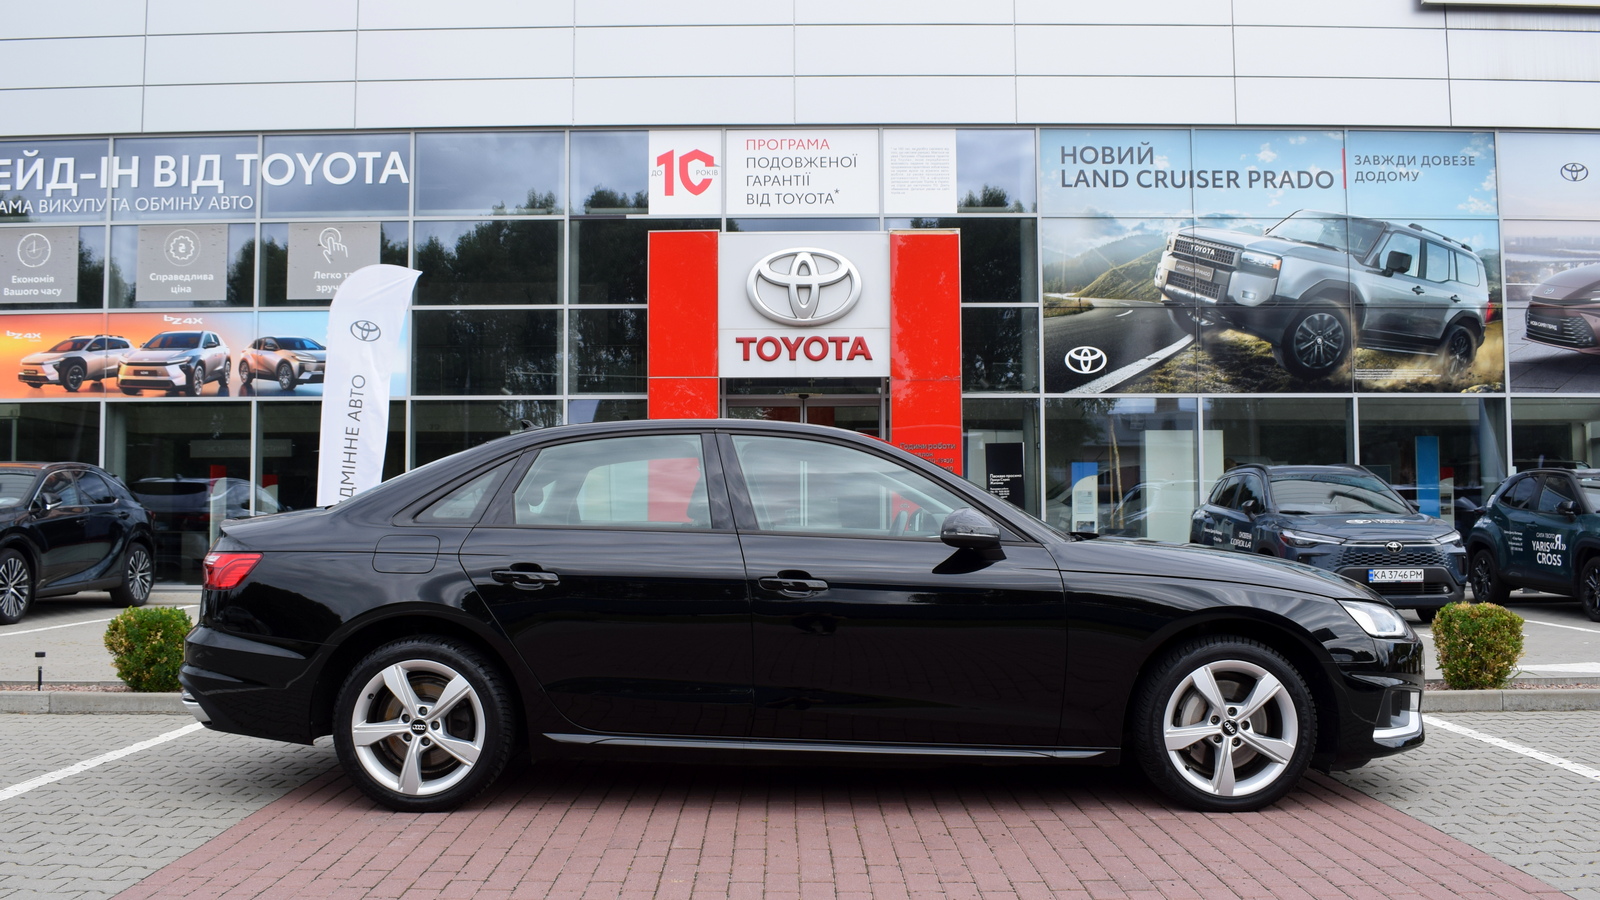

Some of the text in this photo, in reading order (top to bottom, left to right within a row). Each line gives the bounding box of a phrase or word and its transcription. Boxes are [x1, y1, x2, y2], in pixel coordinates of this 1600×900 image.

[746, 138, 830, 151] ПРОГРАМА
[1060, 141, 1154, 165] НОВИЙ
[746, 153, 858, 171] ПОДОВЖЕНОЇ
[1354, 155, 1476, 168] ЗАВЖДИ ДОВЕЗЕ
[154, 155, 224, 194] ВІД
[235, 151, 410, 186] TOYOTA
[651, 169, 663, 177] ДО
[746, 171, 812, 187] ГАРАНТІЇ
[1354, 171, 1420, 183] ДОДОМУ
[1060, 169, 1335, 190] LAND CRUISER PRADO
[38, 198, 107, 213] ВИКУПУ
[111, 197, 131, 212] ТА
[135, 196, 204, 212] ОБМІНУ
[208, 195, 254, 210] АВТО
[746, 193, 771, 207] ВІД
[1190, 244, 1215, 255] TOYOTA
[11, 275, 55, 284] Економія
[149, 272, 214, 282] Справедлива
[313, 270, 342, 280] Легко
[3, 287, 62, 297] Вашого часу
[170, 285, 192, 295] ціна
[735, 335, 873, 362] TOYOTA
[347, 374, 366, 422] АВТО
[1230, 537, 1252, 549] COROLLA
[1532, 541, 1550, 552] YARIS
[1536, 552, 1562, 566] CROSS
[1388, 570, 1409, 580] 3746
